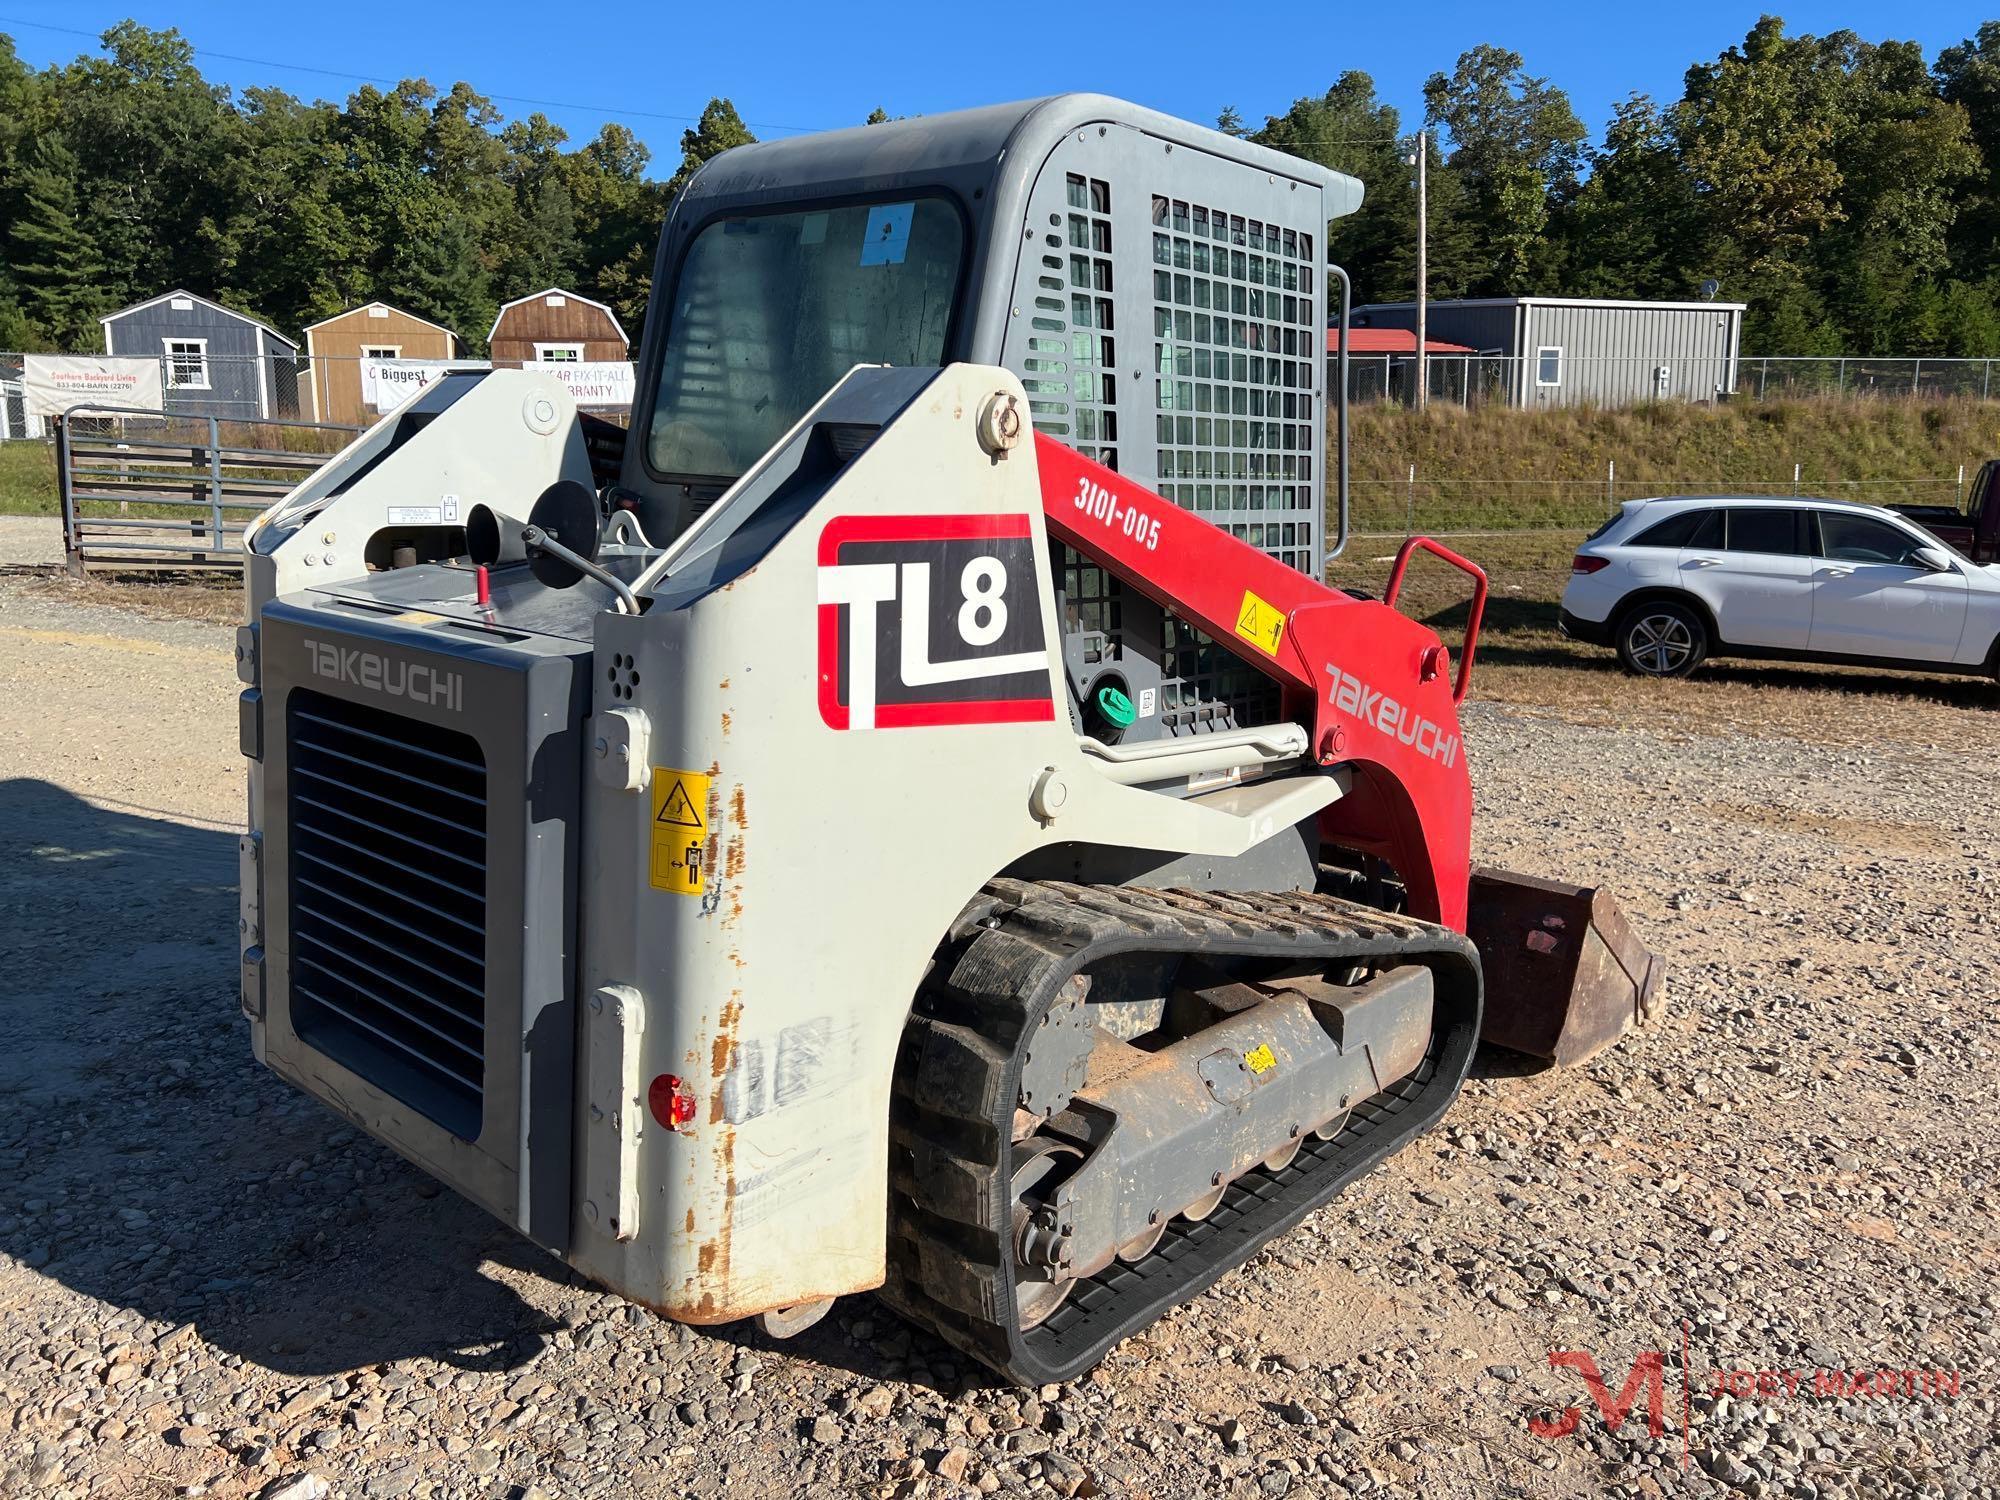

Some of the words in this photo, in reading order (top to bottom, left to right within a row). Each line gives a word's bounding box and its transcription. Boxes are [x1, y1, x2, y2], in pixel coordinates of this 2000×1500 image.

[84, 372, 114, 382] Backyard
[116, 374, 136, 383] Living
[382, 368, 425, 383] Biggest
[568, 385, 613, 397] RRANTY
[1074, 477, 1161, 551] 3101-005
